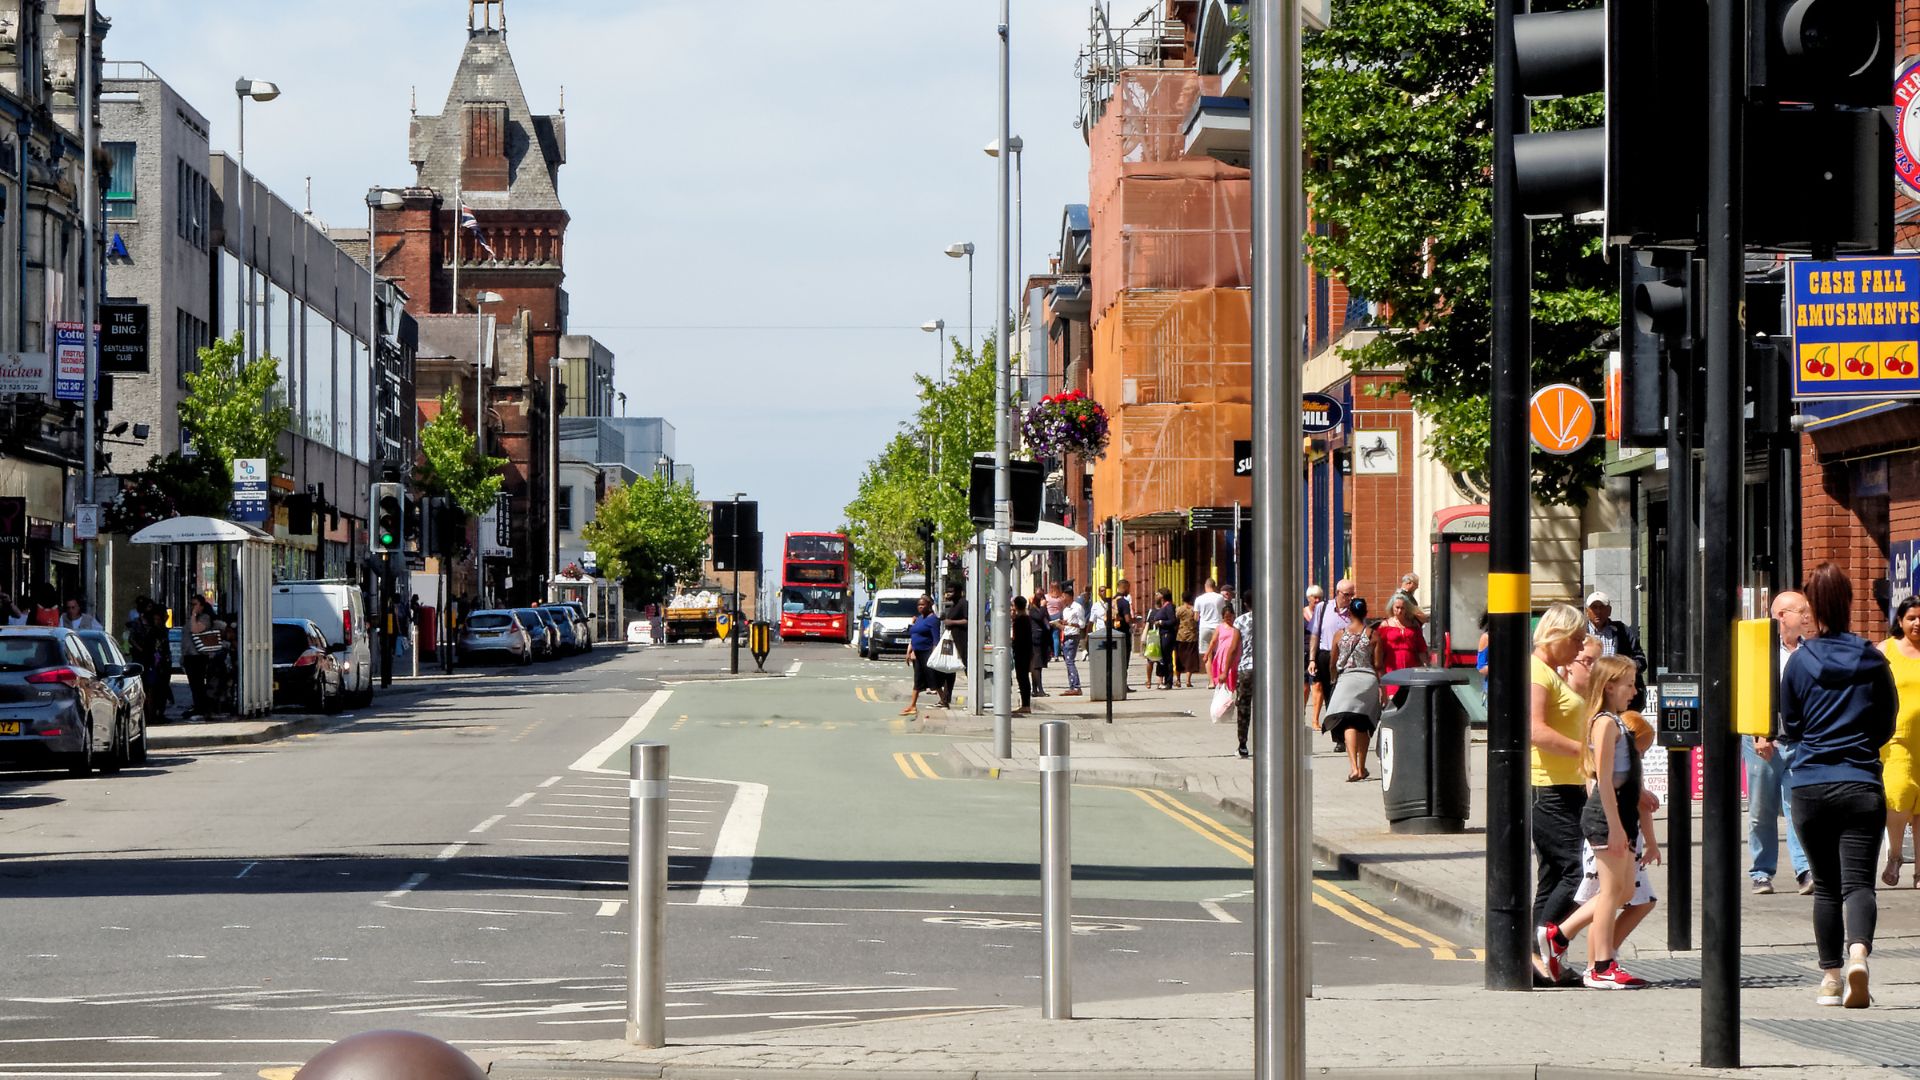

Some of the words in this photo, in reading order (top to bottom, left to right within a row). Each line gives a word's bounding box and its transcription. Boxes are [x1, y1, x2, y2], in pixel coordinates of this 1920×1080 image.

[1809, 271, 1855, 294] CASH
[1861, 269, 1906, 293] FALL
[114, 313, 134, 323] THE
[1797, 301, 1920, 327] AMUSEMENTS
[111, 325, 137, 334] BING
[1303, 411, 1330, 425] HILL
[1895, 553, 1907, 579] Cash
[1665, 699, 1694, 707] WAIT
